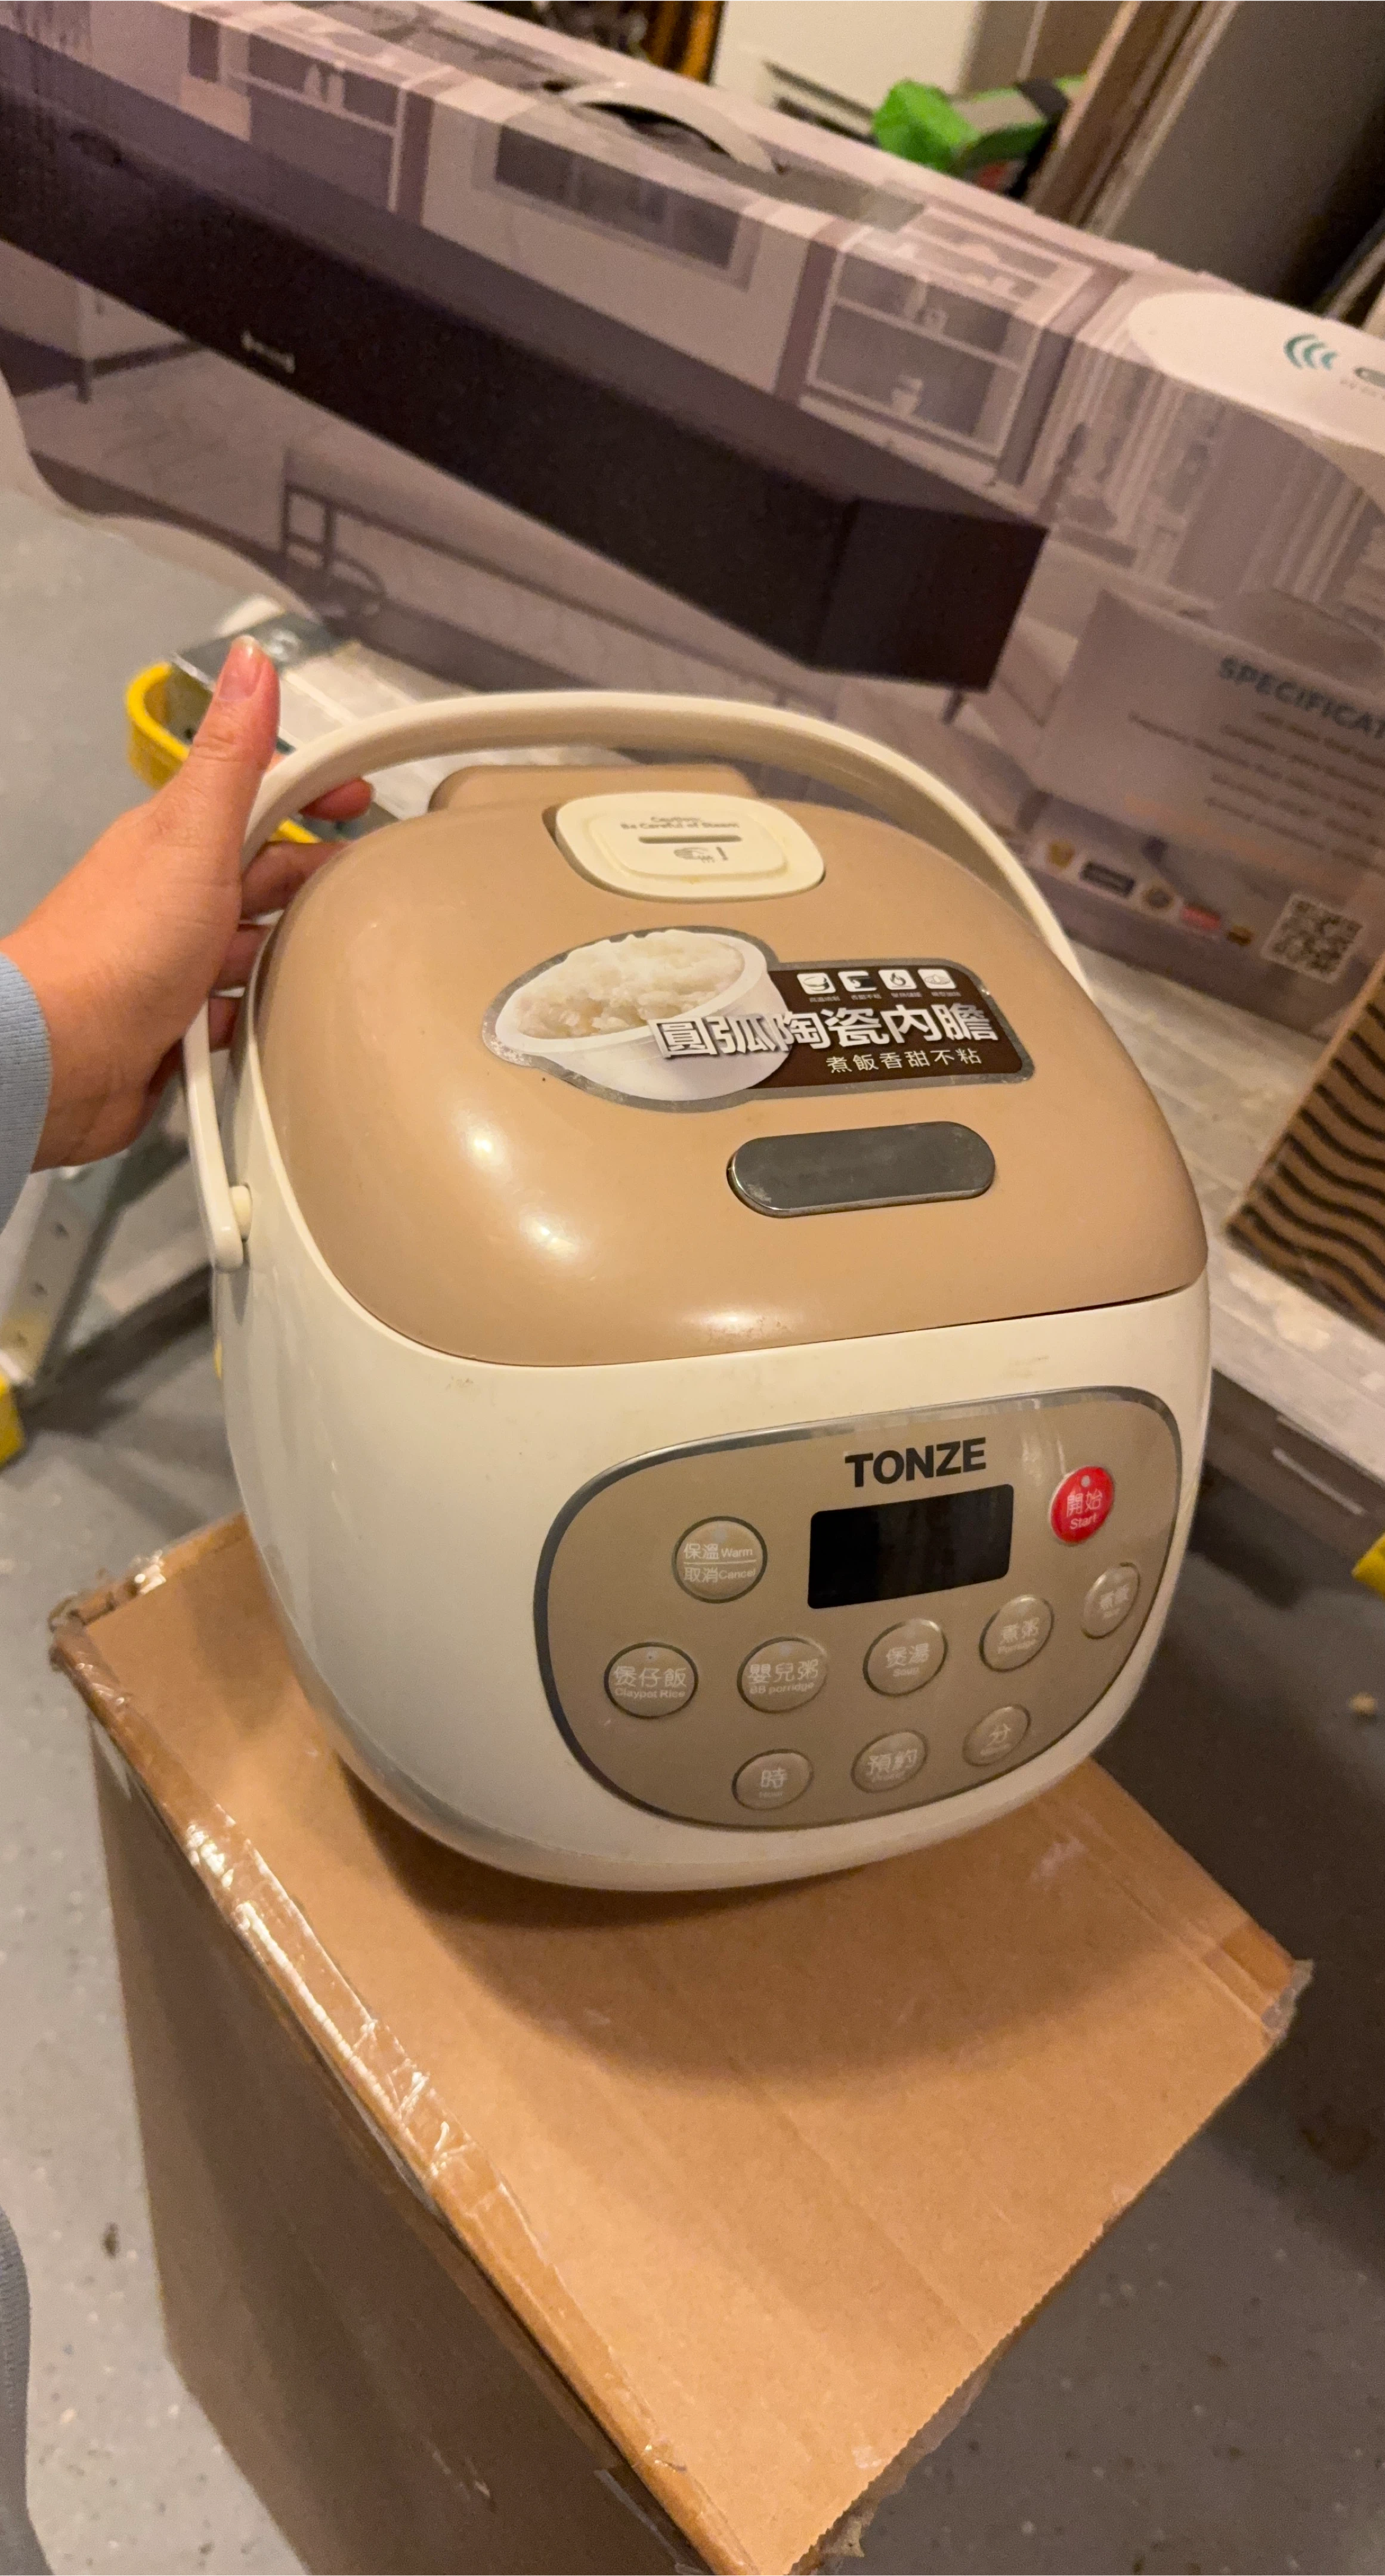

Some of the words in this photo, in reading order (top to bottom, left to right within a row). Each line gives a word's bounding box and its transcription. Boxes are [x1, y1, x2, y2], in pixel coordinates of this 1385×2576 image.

[826, 1048, 982, 1074] 煮飯香甜不粘
[845, 1437, 987, 1487] TONZE
[1066, 1488, 1103, 1518] 開始
[1069, 1513, 1098, 1530] Start
[721, 1548, 753, 1558] Warm
[684, 1566, 718, 1583] 取消
[719, 1568, 756, 1580] Cancel
[613, 1665, 687, 1688] 煲仔飯
[747, 1658, 818, 1685] 嬰兒粥
[614, 1688, 656, 1699] Claypot
[660, 1689, 685, 1698] Rice
[768, 1682, 815, 1695] porridge
[867, 1749, 917, 1773] 預約
[760, 1767, 788, 1788] 時
